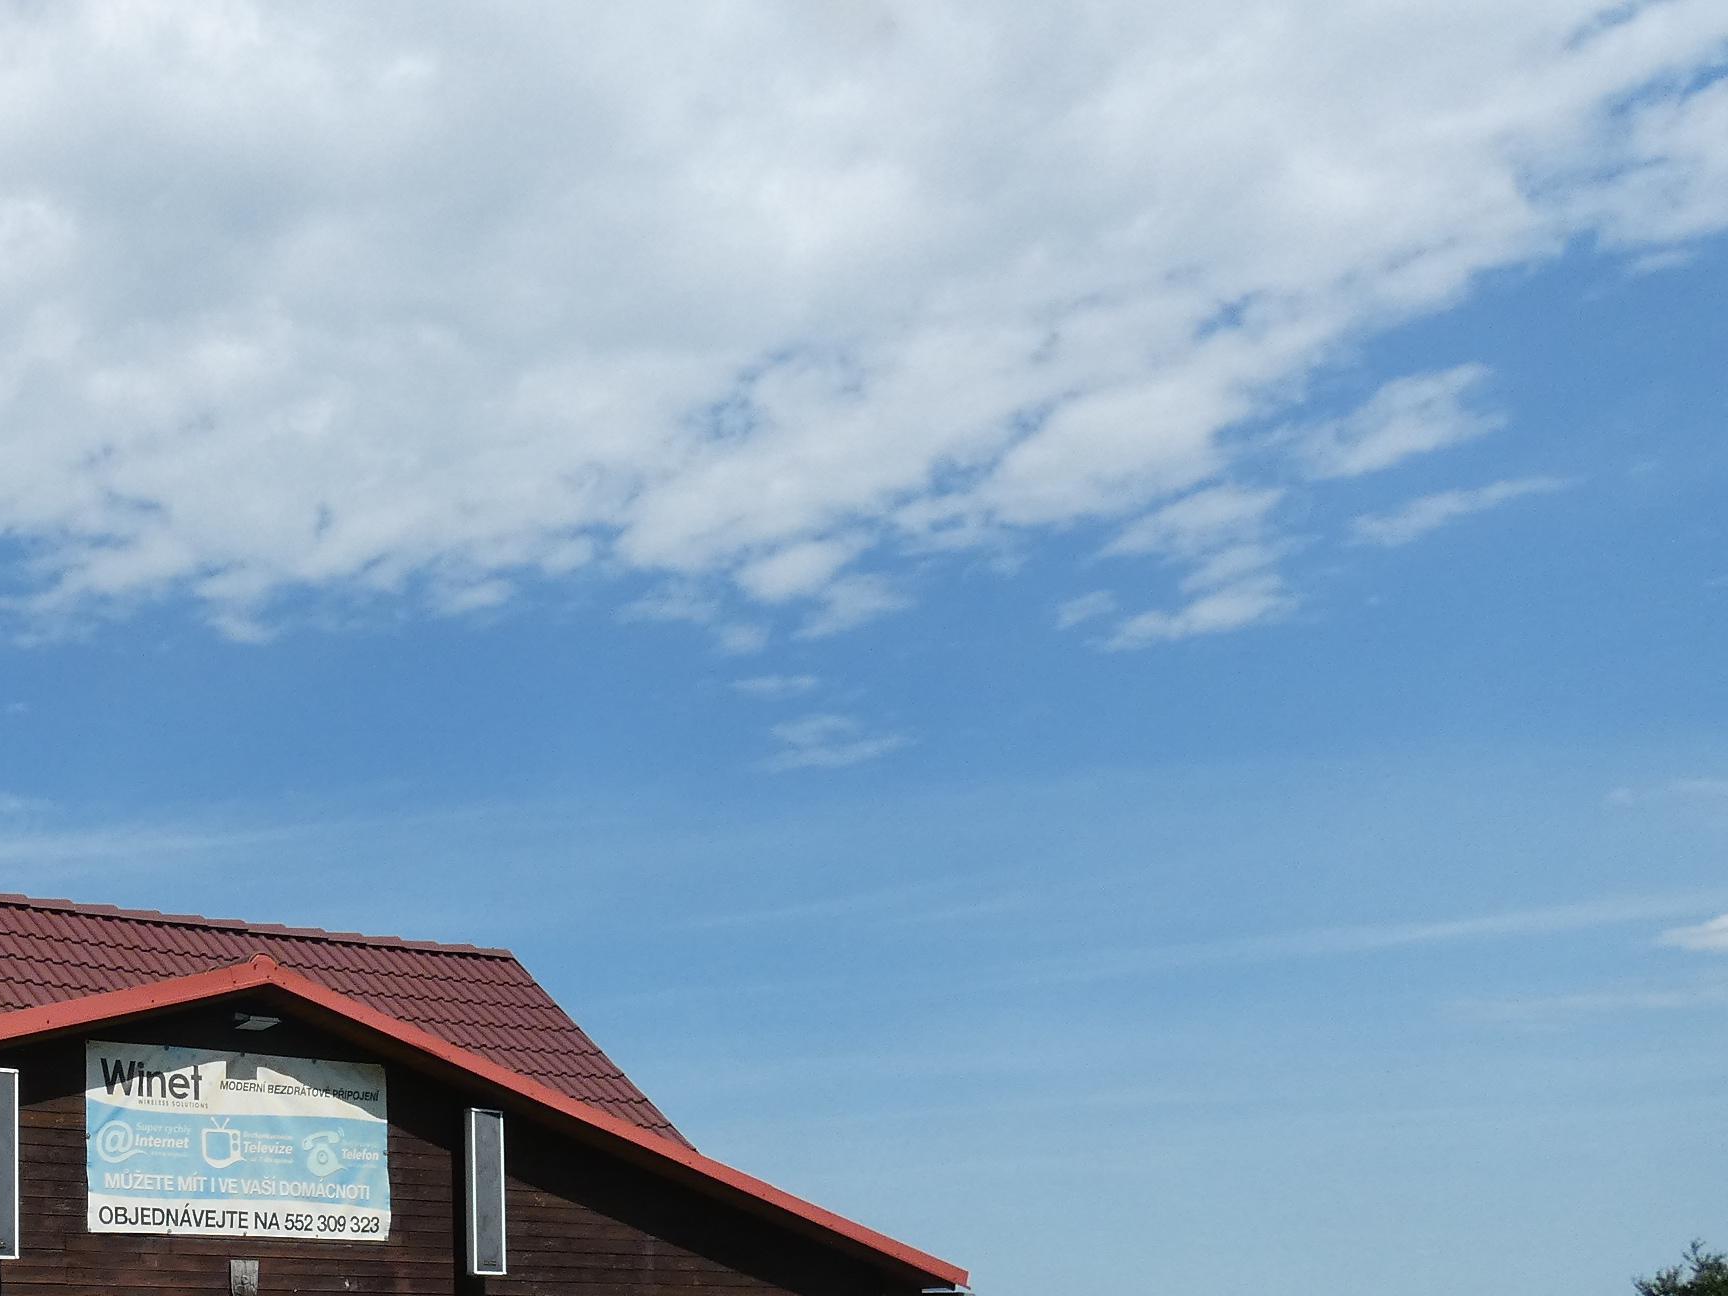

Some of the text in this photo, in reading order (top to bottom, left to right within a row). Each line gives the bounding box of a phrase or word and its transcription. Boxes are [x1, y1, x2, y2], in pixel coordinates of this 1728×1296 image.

[100, 1058, 202, 1100] Winet
[219, 1080, 380, 1102] MODERNÍ BEZDRÁTOVÉ PŘIPOJENÍ
[138, 1099, 209, 1109] WIRELESS SOLUTIONS
[135, 1134, 190, 1149] Internet
[243, 1141, 293, 1154] Televize
[341, 1147, 379, 1160] Telefon
[104, 1168, 370, 1201] MŮŽETE MÍT I VE VAŠÍ DOMÁCNOTI
[98, 1203, 380, 1233] OBJEDNÁVEJTE NA 552 309 323
